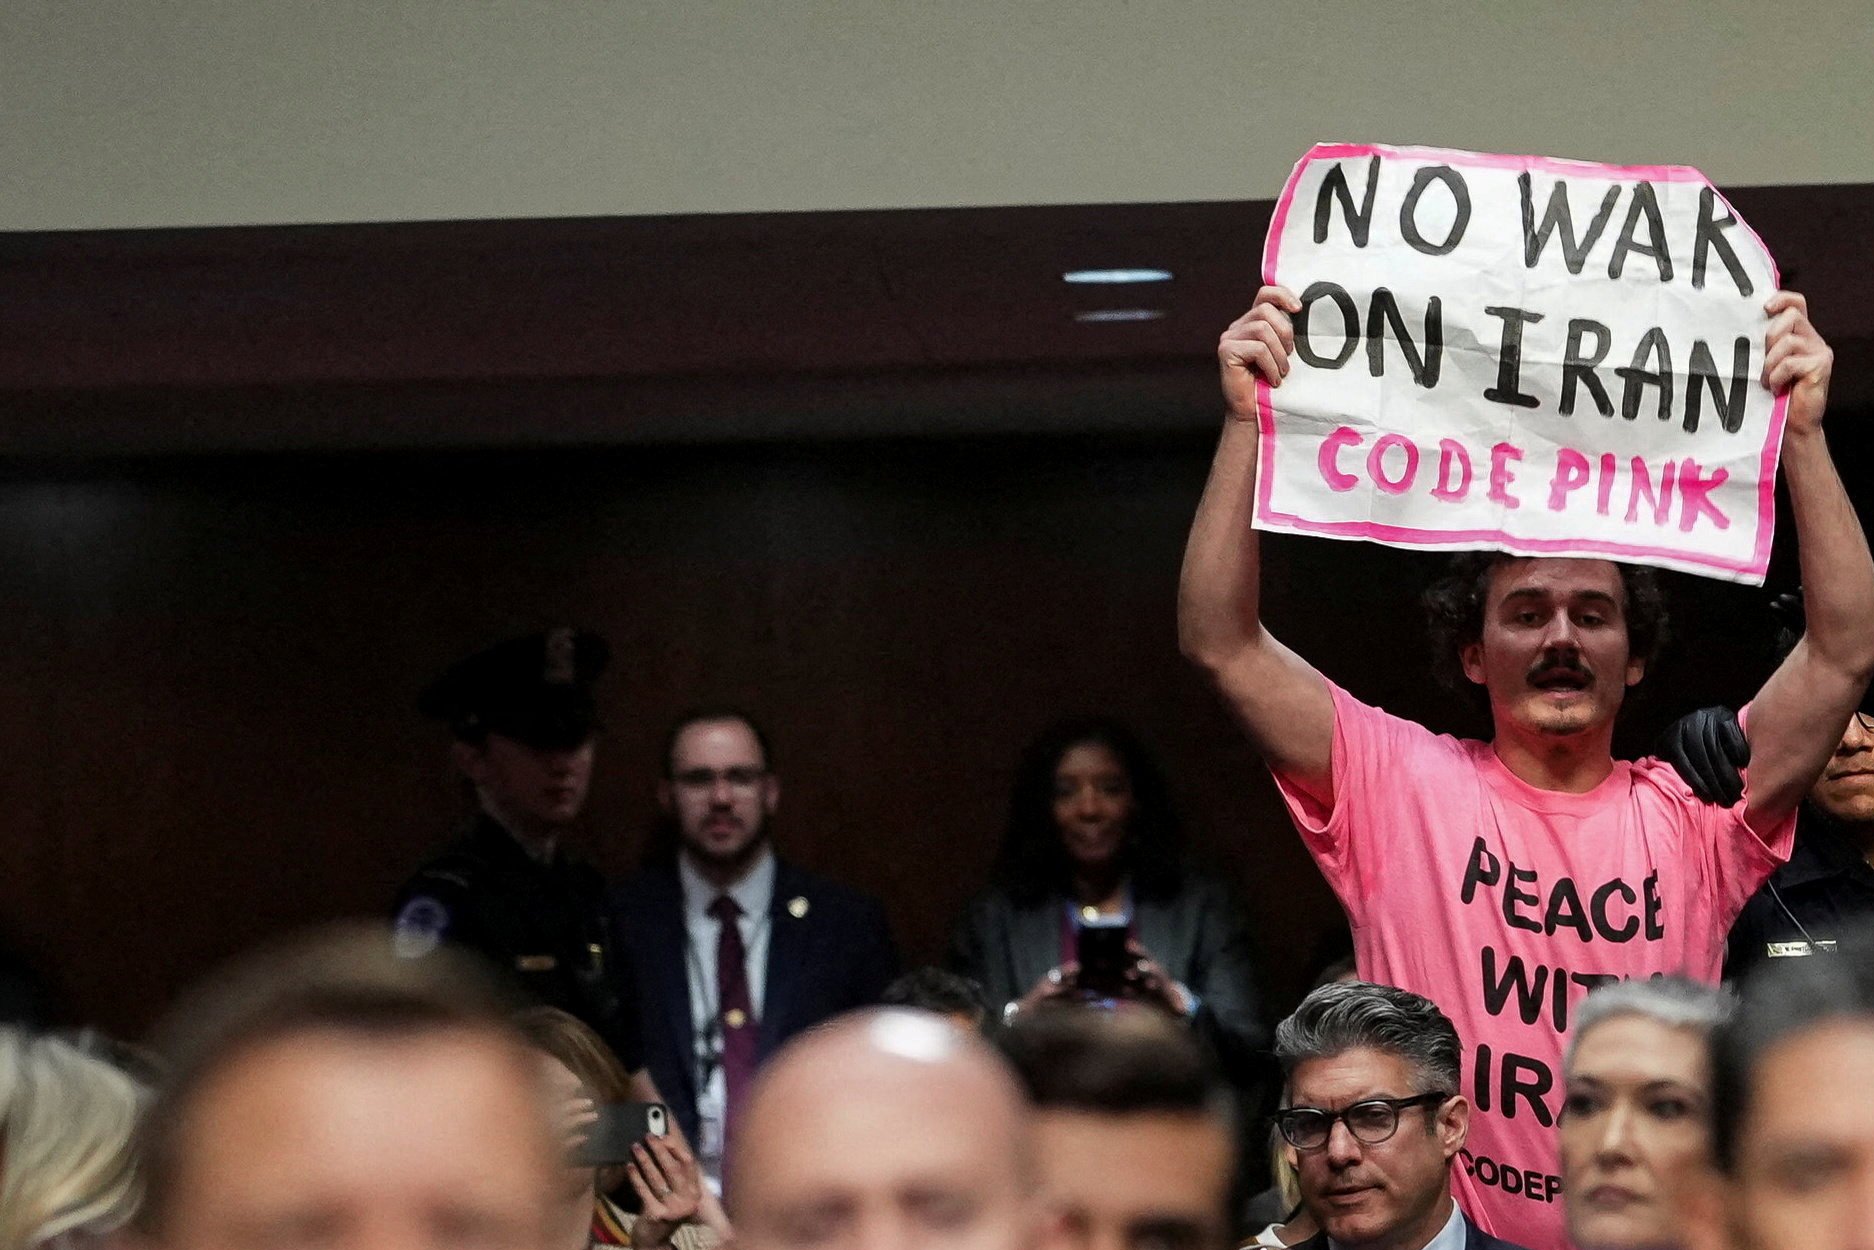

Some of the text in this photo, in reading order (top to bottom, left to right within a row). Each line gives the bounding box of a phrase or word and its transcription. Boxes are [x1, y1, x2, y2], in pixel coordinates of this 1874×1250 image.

[1313, 155, 1754, 297] NO WAR
[1293, 281, 1751, 434] ON IRAN
[1317, 426, 1730, 532] CODE PINK
[1481, 946, 1664, 1033] WIT
[1474, 1044, 1566, 1128] IR
